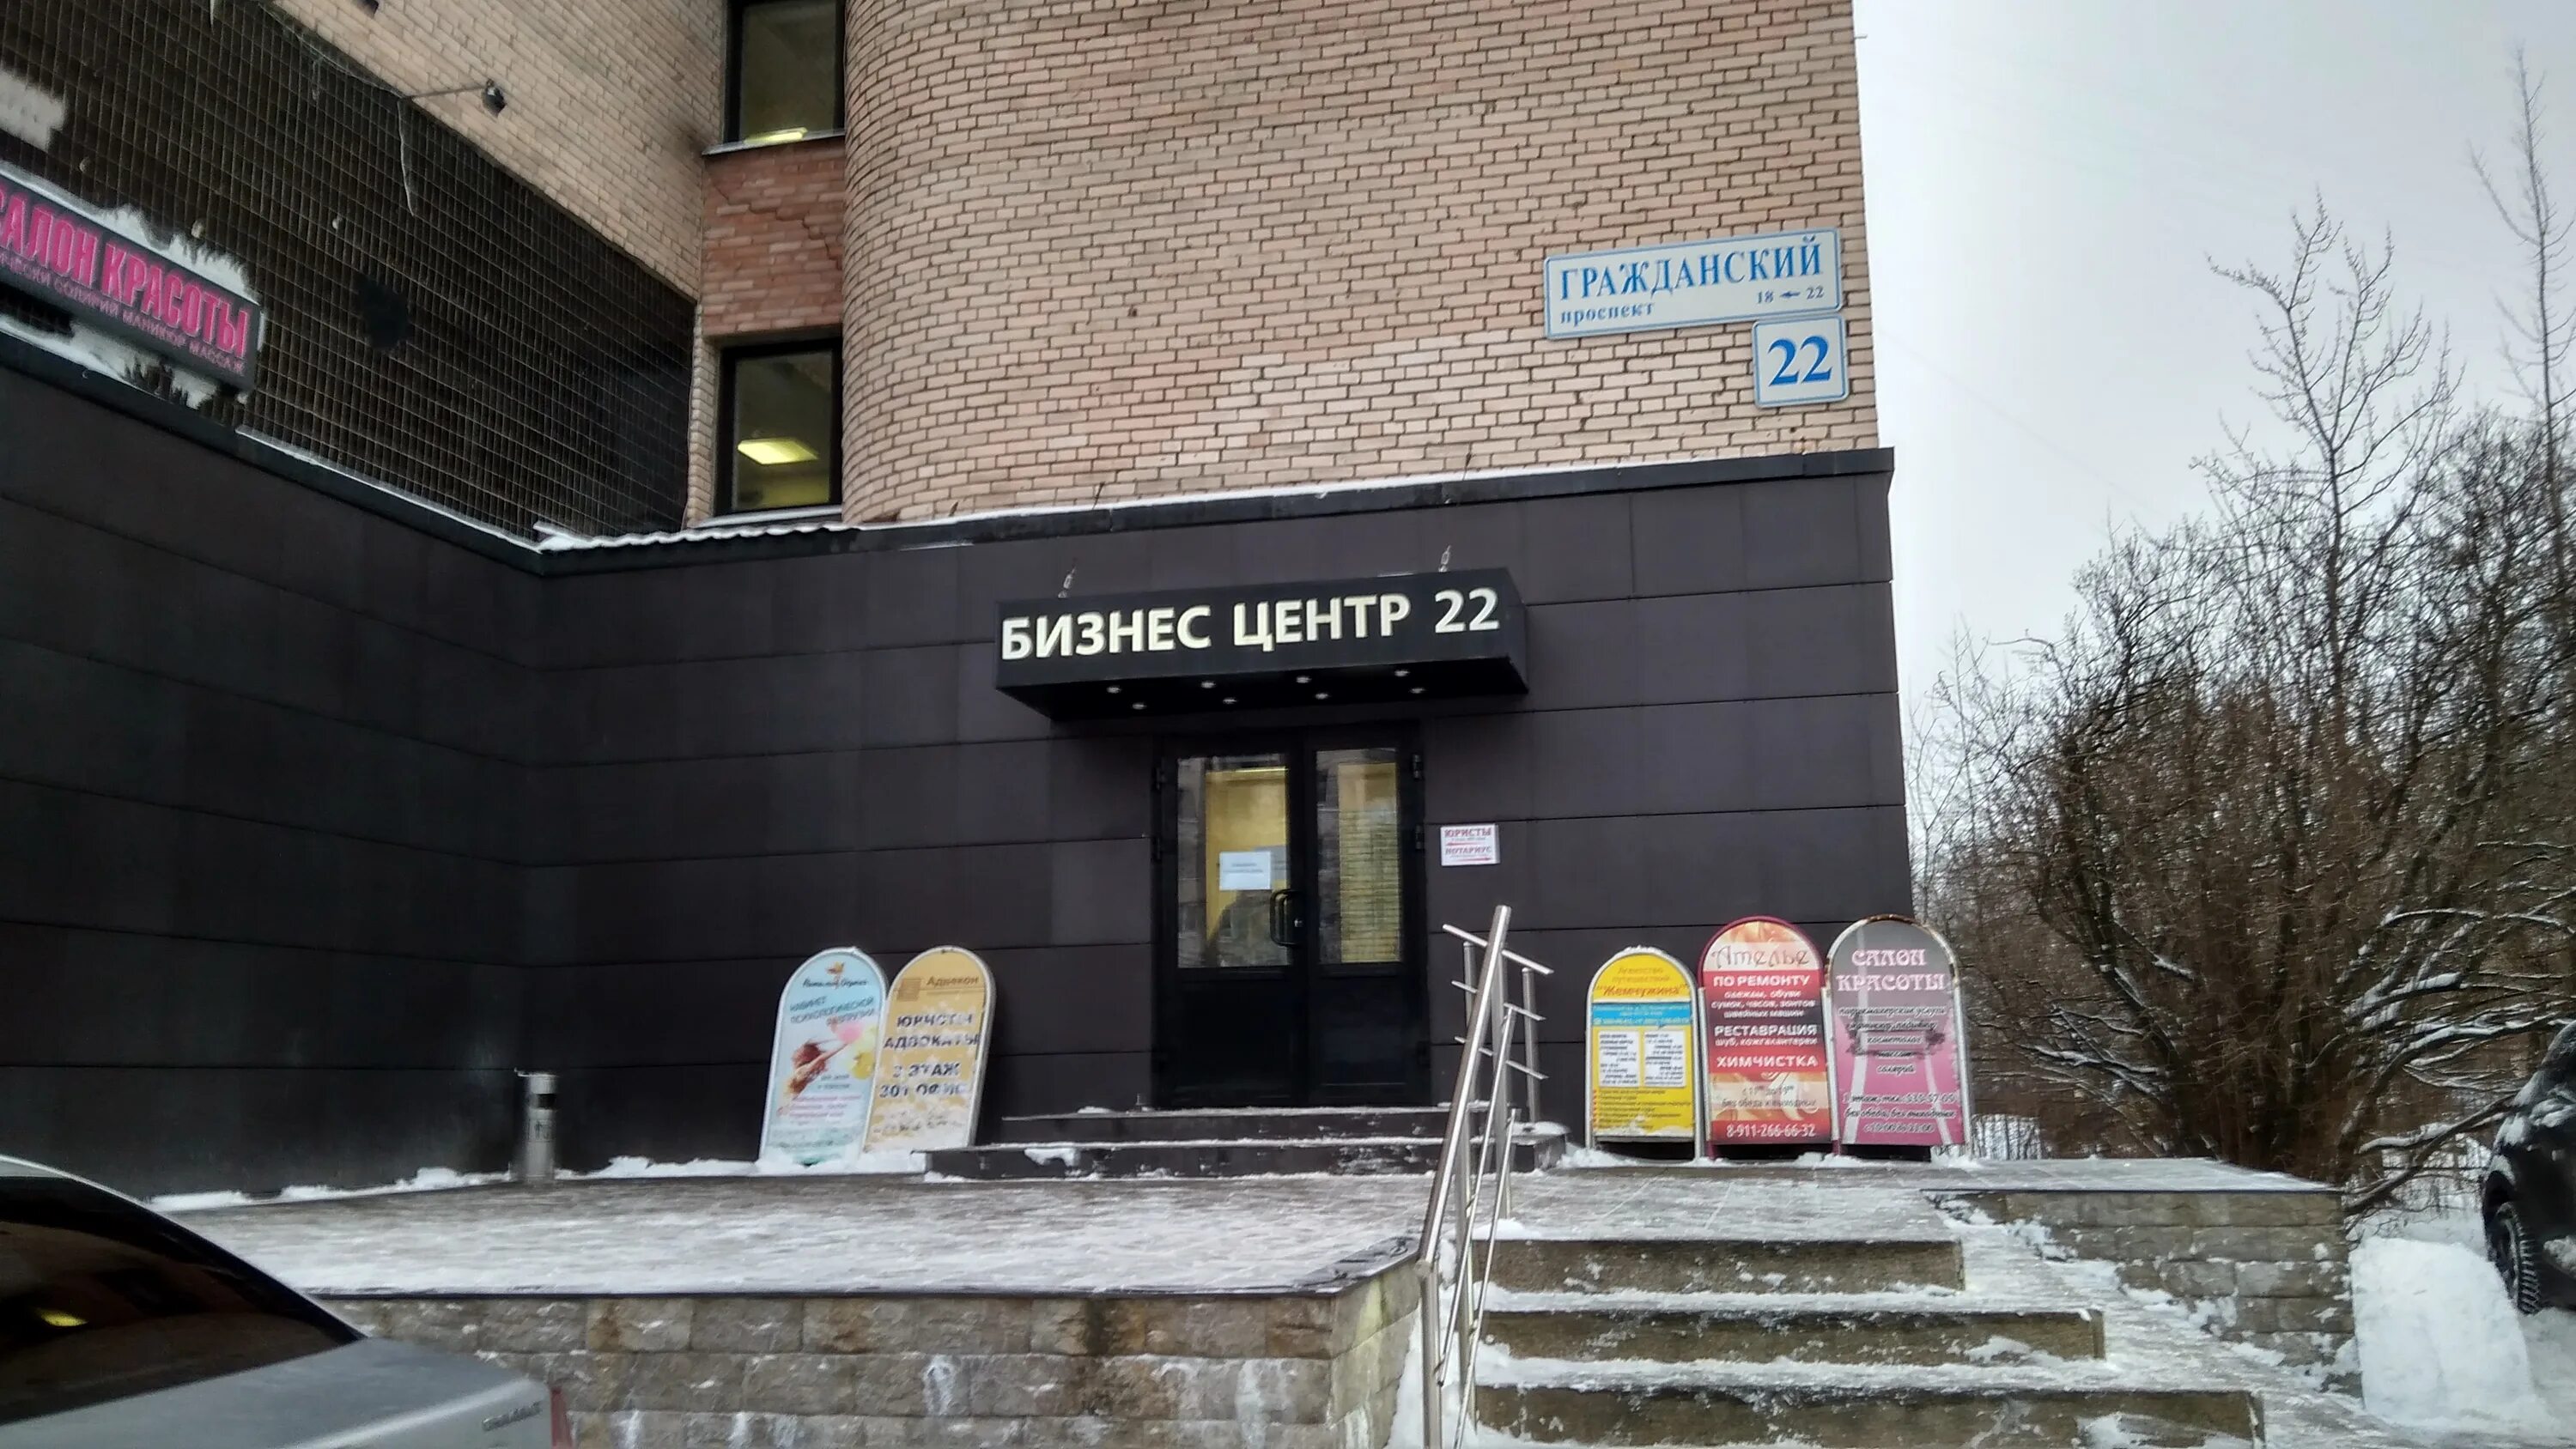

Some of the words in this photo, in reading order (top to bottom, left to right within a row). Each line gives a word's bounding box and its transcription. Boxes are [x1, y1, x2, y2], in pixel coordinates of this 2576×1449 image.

[1559, 234, 1823, 301] ГРАЖДАНСКИЙ
[100, 241, 249, 360] КРАСОТЫ
[1757, 289, 1775, 305] 18
[1806, 285, 1825, 300] 22
[1560, 302, 1656, 327] проспект
[1767, 334, 1833, 387] 22
[1001, 604, 1212, 660] БИЗНЕС
[1231, 593, 1412, 652] ЦЕНТР
[1434, 587, 1502, 634] 22
[1443, 828, 1492, 838] ЮРИСТЫ
[1445, 846, 1492, 855] НОТАРИУС
[1711, 943, 1810, 969] Ателье
[1851, 949, 1927, 967] САЛОН
[1713, 975, 1735, 987] ПО
[1736, 975, 1811, 986] РЕМОНТУ
[1835, 973, 1947, 991] КРАСОТЫ
[1714, 1024, 1819, 1037] РЕСТАВРАЦИЯ
[1716, 1055, 1819, 1068] ХИМЧИСТКА
[1726, 1123, 1816, 1138] 8-911-266-66-32
